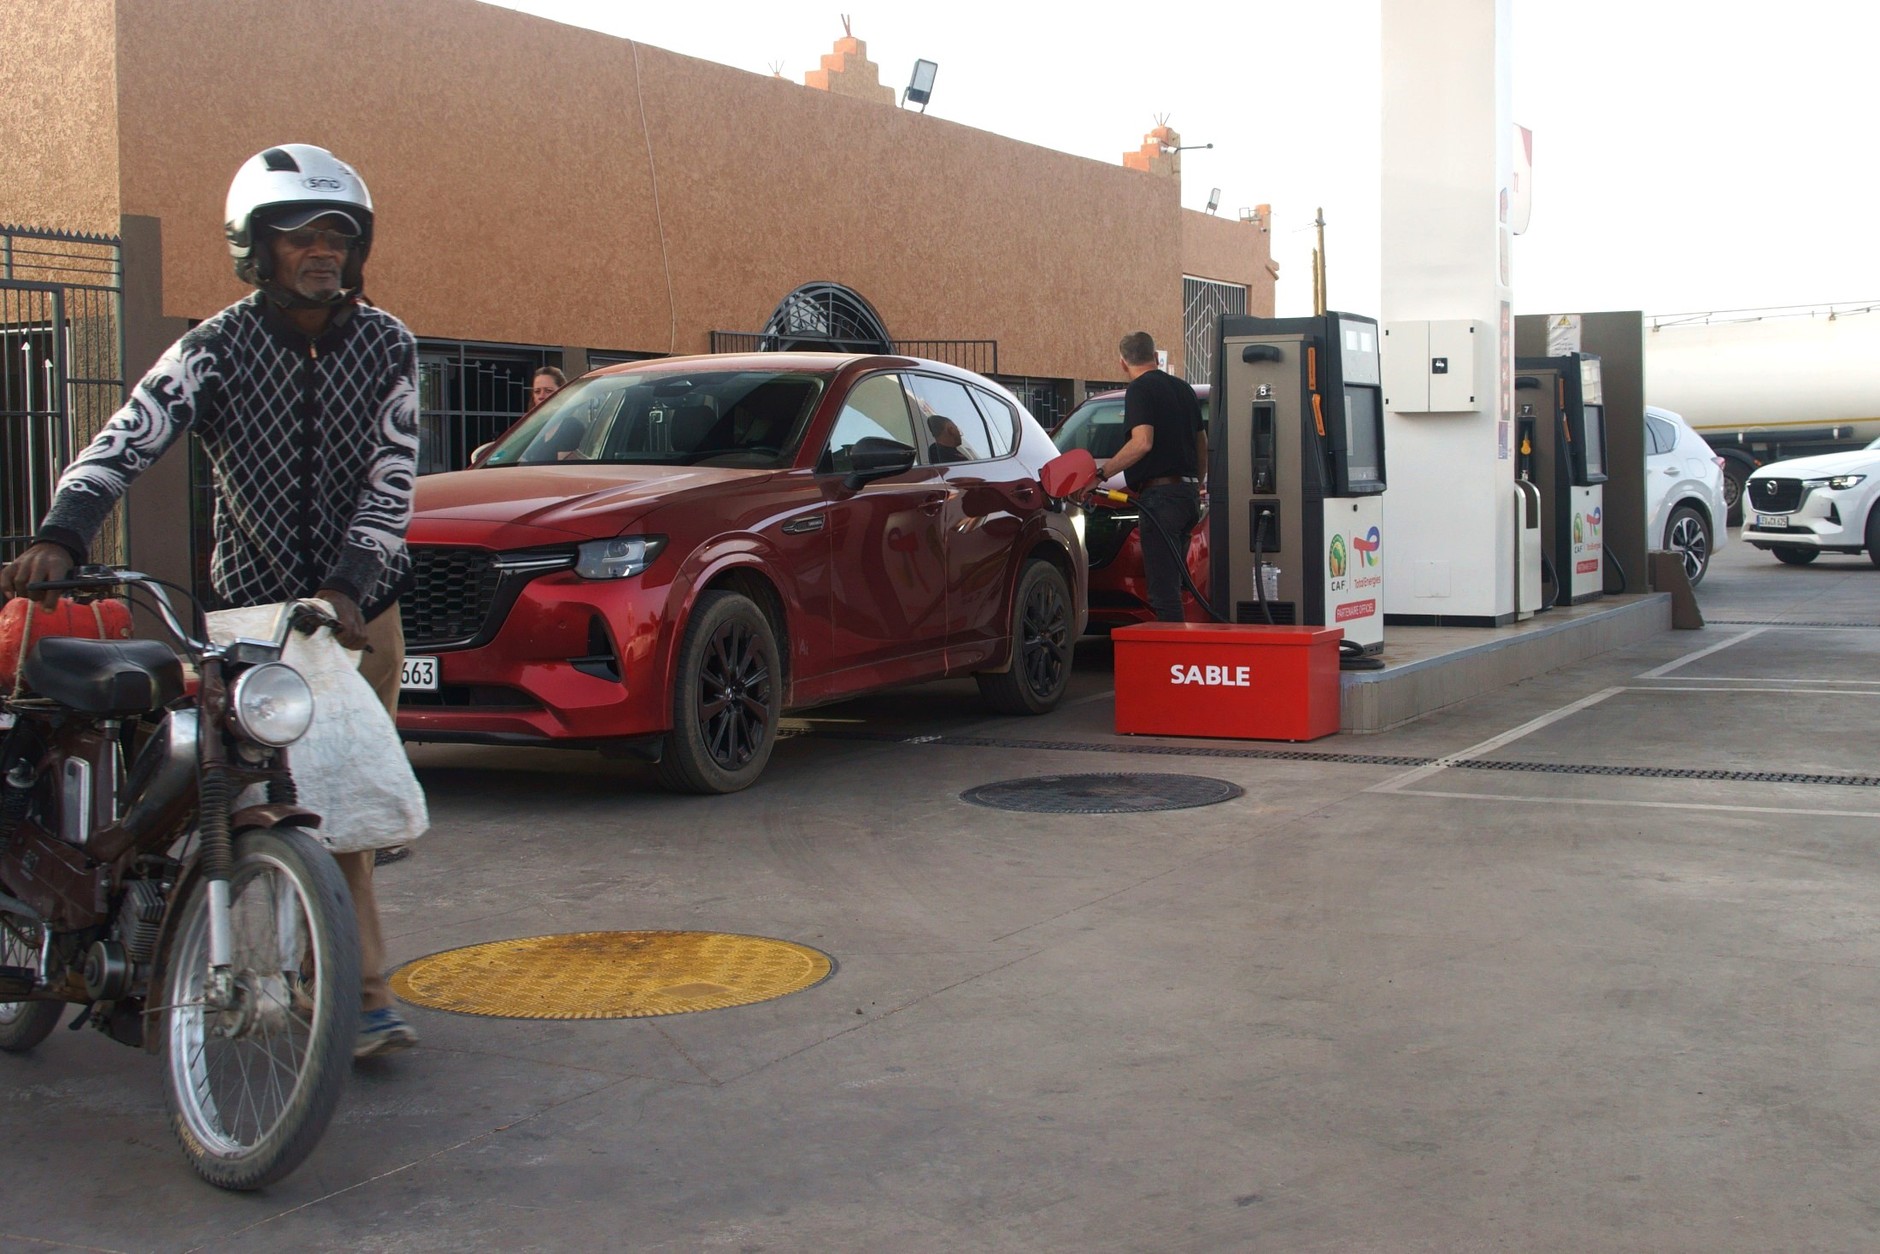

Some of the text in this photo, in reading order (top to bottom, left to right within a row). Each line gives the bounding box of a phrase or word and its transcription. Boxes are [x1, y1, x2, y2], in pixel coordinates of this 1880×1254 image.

[1331, 580, 1346, 592] CAF
[401, 661, 433, 685] 663
[1170, 664, 1251, 687] SABLE
